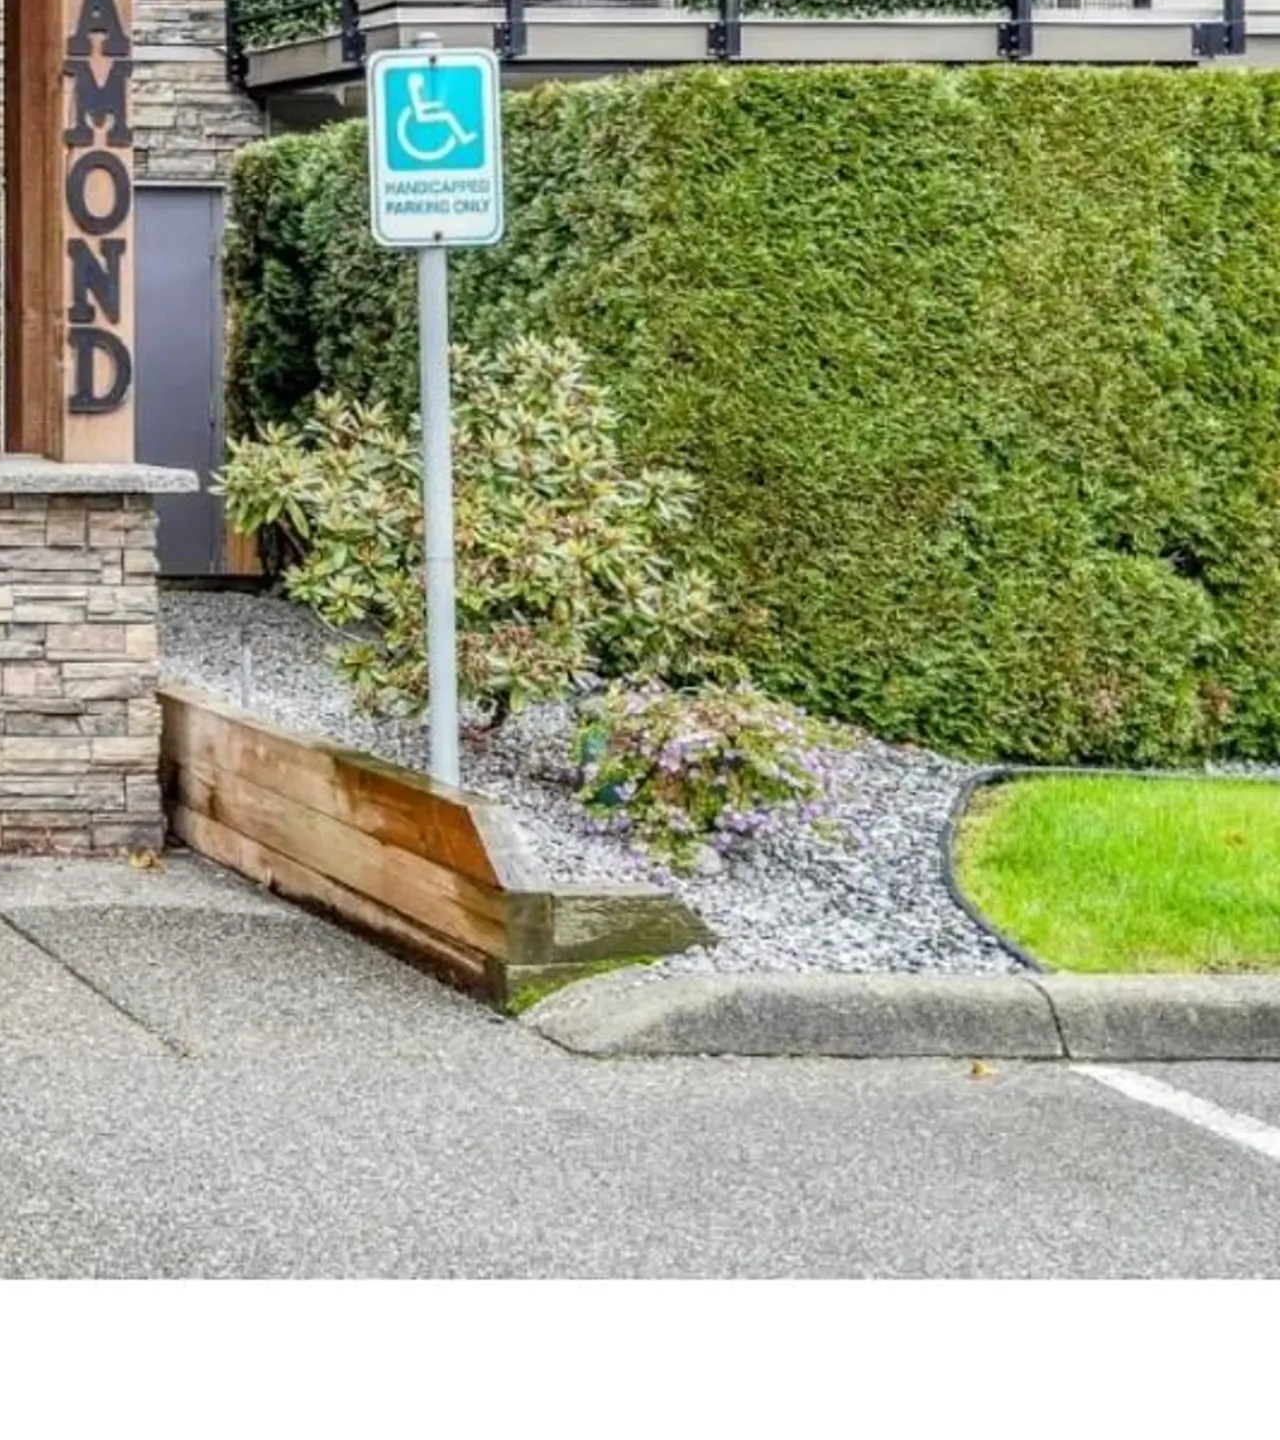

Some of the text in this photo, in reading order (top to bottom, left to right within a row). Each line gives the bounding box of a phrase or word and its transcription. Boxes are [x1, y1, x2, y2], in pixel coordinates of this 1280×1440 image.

[385, 179, 490, 194] HANDICAPPED
[385, 200, 490, 214] PARKING ONLY
